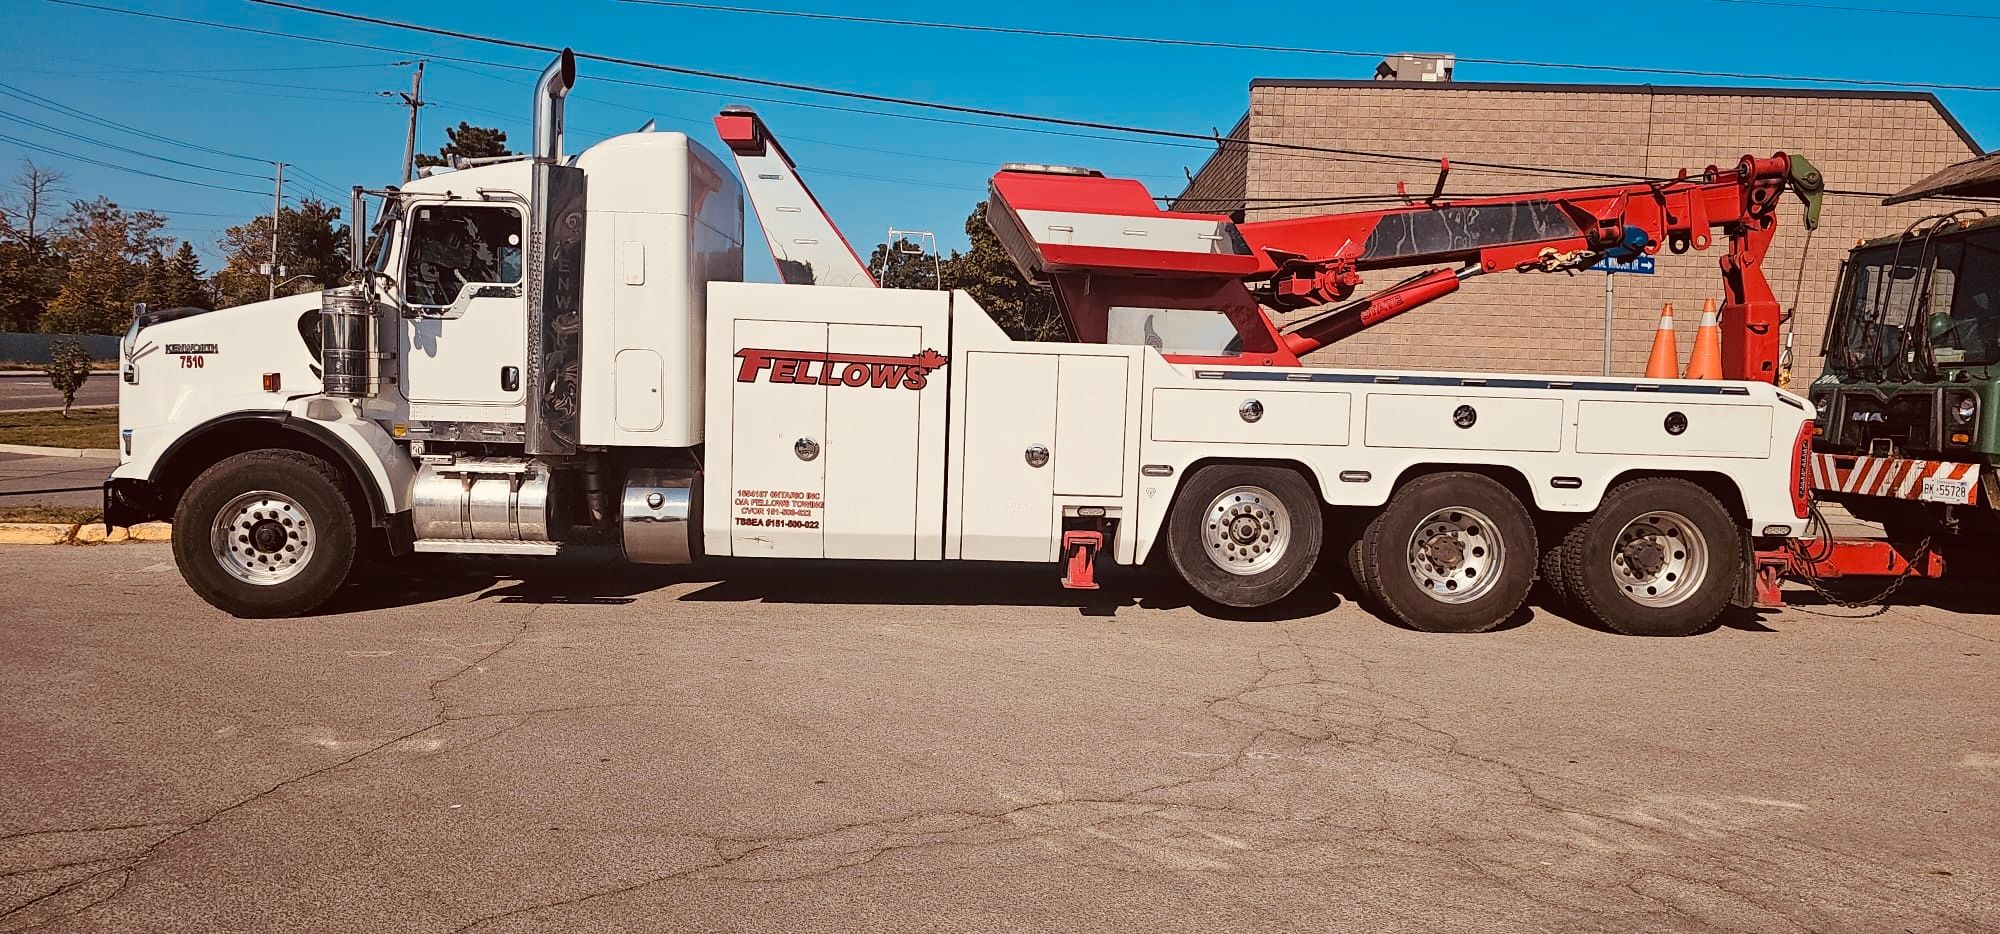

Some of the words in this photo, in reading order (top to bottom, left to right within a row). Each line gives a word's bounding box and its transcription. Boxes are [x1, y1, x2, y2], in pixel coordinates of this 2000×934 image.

[165, 343, 219, 355] KENWORTH
[179, 355, 205, 369] 7510
[734, 348, 929, 391] FELLOWS
[770, 490, 804, 500] ONTARIO
[806, 491, 821, 500] INC
[1924, 483, 1935, 495] BK
[1939, 484, 1966, 498] 55728
[751, 498, 790, 508] FELLOWS
[791, 500, 825, 509] TOWING
